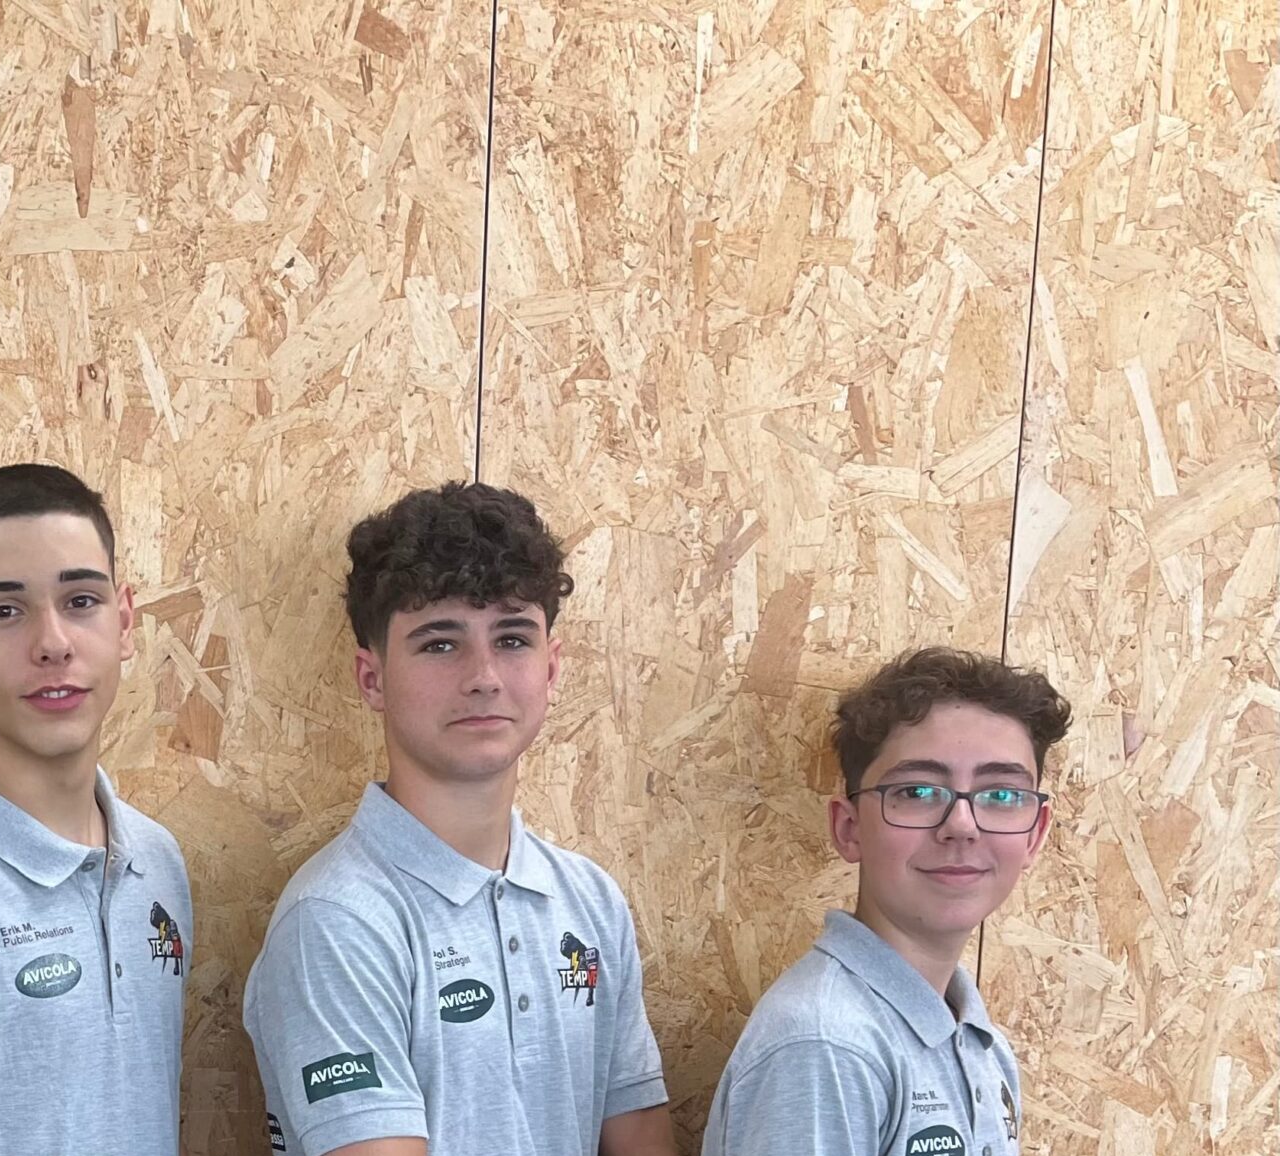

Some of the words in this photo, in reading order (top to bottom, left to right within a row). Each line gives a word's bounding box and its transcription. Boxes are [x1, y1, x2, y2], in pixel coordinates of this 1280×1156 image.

[0, 925, 21, 937] Erik
[22, 922, 36, 932] M.
[2, 934, 34, 948] Public
[34, 925, 74, 941] Relations
[447, 946, 458, 956] S.
[23, 961, 77, 986] AVICOLA
[439, 986, 489, 1010] AVICOLA
[910, 1135, 962, 1154] AVICOLA
